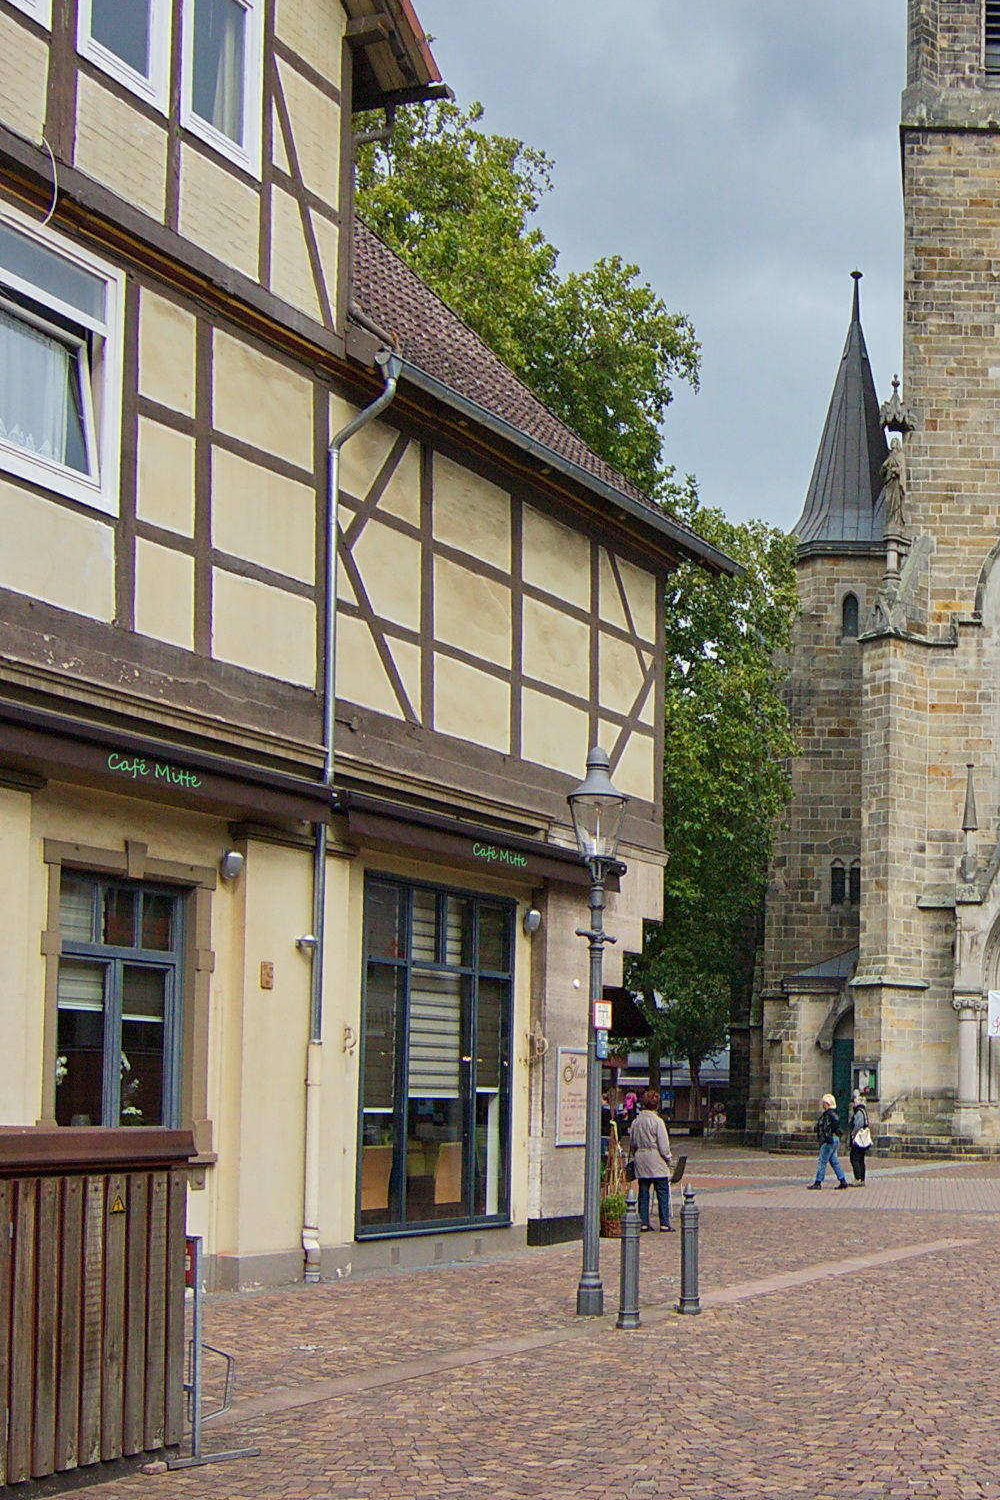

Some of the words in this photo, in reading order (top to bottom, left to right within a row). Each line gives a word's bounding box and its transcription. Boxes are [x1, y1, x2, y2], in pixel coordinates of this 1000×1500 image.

[107, 753, 150, 779] Café
[155, 763, 202, 788] Mitte
[472, 842, 498, 863] Café
[499, 849, 528, 867] Mitte
